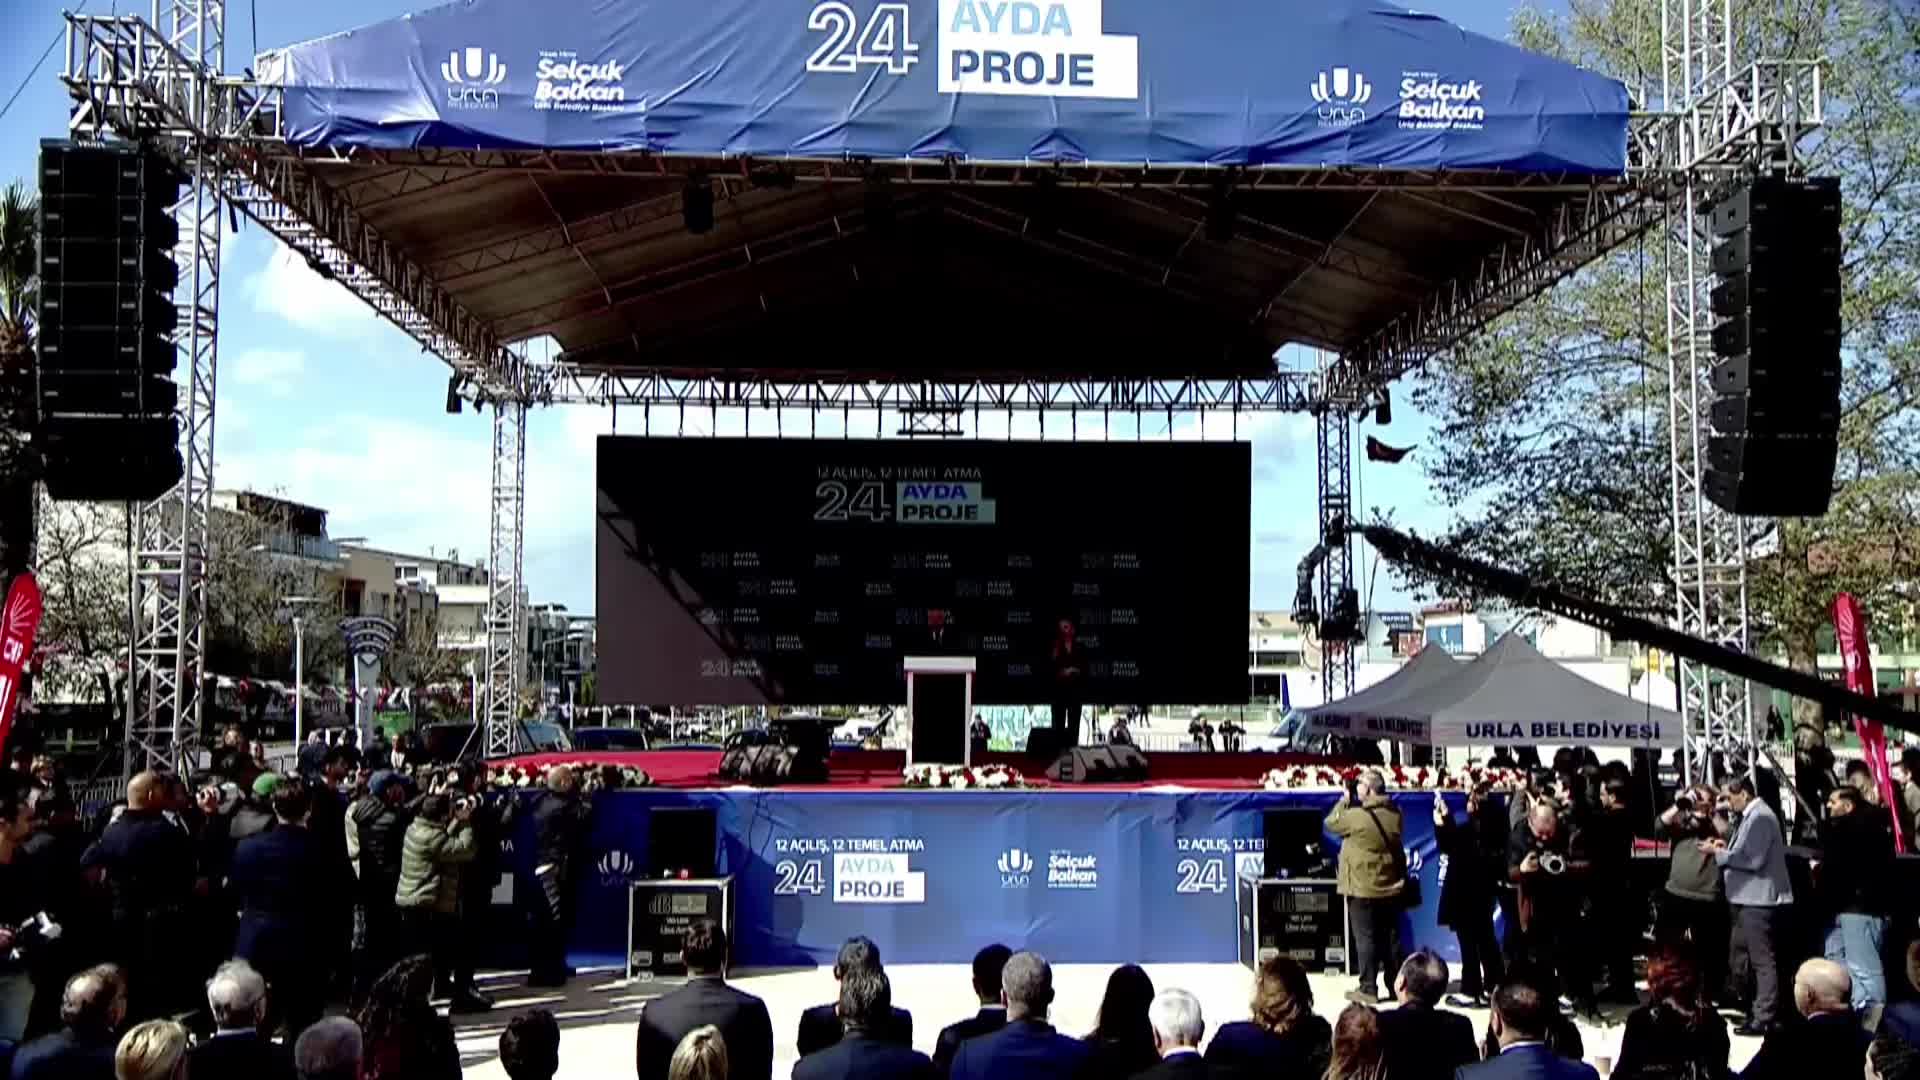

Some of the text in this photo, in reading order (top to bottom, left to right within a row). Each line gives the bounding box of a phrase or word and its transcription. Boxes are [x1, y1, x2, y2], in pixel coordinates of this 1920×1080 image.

[950, 0, 1073, 36] AYDA
[806, 1, 919, 75] 24
[536, 58, 624, 85] Selçuk
[951, 49, 1094, 87] PROJE
[535, 80, 624, 101] Balkan
[1399, 78, 1483, 102] Selçuk
[1399, 100, 1484, 120] Balkan
[813, 480, 892, 523] 24
[903, 485, 968, 499] AYDA
[903, 504, 979, 520] PROJE
[1466, 719, 1661, 740] URLA BELEDİYESİ
[776, 839, 925, 855] 12 AÇILIŞ, 12 TEMEL ATMA
[1177, 839, 1189, 850] 12
[1191, 839, 1231, 854] AÇILIŞ,
[1233, 839, 1245, 850] 12
[840, 858, 896, 874] AYDA
[1048, 855, 1097, 869] Selçuk
[774, 859, 826, 895] 24
[1048, 868, 1097, 882] Balkan
[1177, 859, 1227, 894] 24
[839, 880, 905, 898] PROJE
